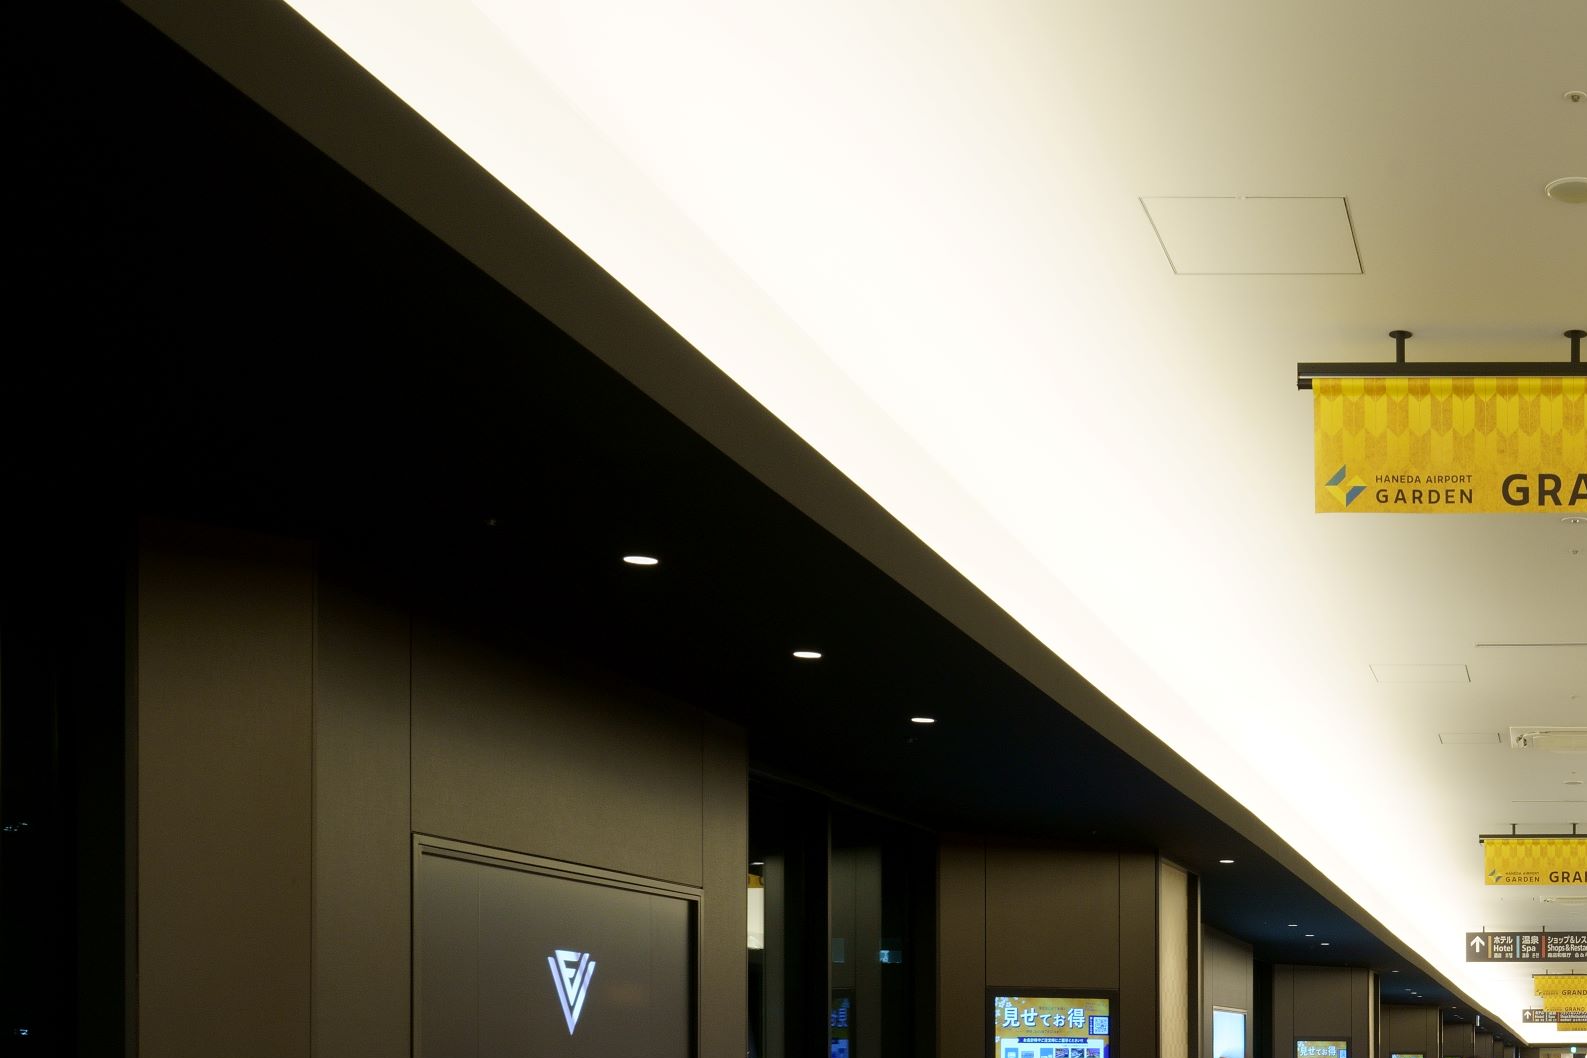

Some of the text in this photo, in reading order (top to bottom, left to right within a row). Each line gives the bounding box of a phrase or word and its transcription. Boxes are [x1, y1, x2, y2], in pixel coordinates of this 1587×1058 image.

[1375, 474, 1473, 485] HANEDA AIRPORT
[1375, 488, 1473, 504] GARDEN
[1493, 935, 1513, 944] ホテル
[1521, 935, 1539, 944] 温泉
[1493, 944, 1513, 952] Hotel
[1521, 944, 1537, 953] Spa
[1002, 1007, 1087, 1029] 見せてお得
